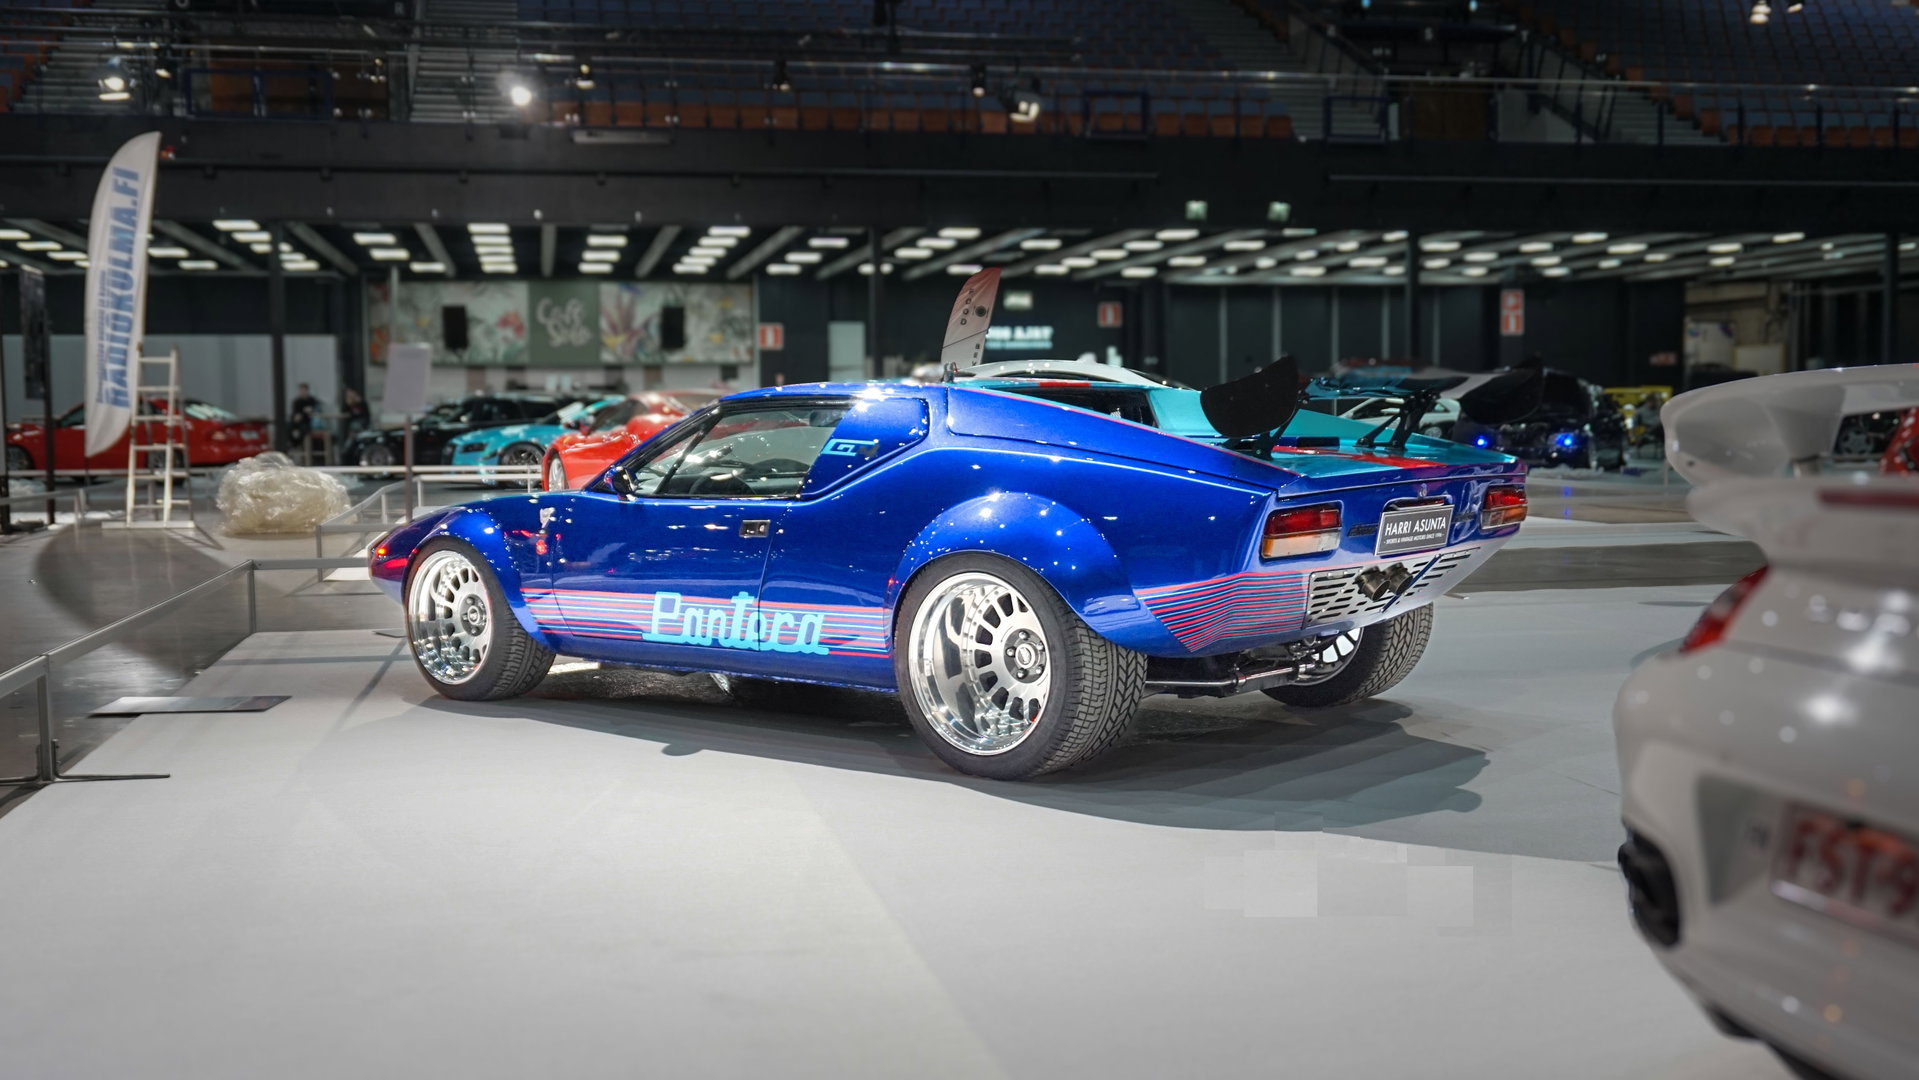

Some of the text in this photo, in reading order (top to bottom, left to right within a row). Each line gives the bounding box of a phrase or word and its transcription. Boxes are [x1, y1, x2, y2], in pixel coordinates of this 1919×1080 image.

[1385, 517, 1446, 536] HARRI ASUNTA
[642, 591, 829, 656] Pantera
